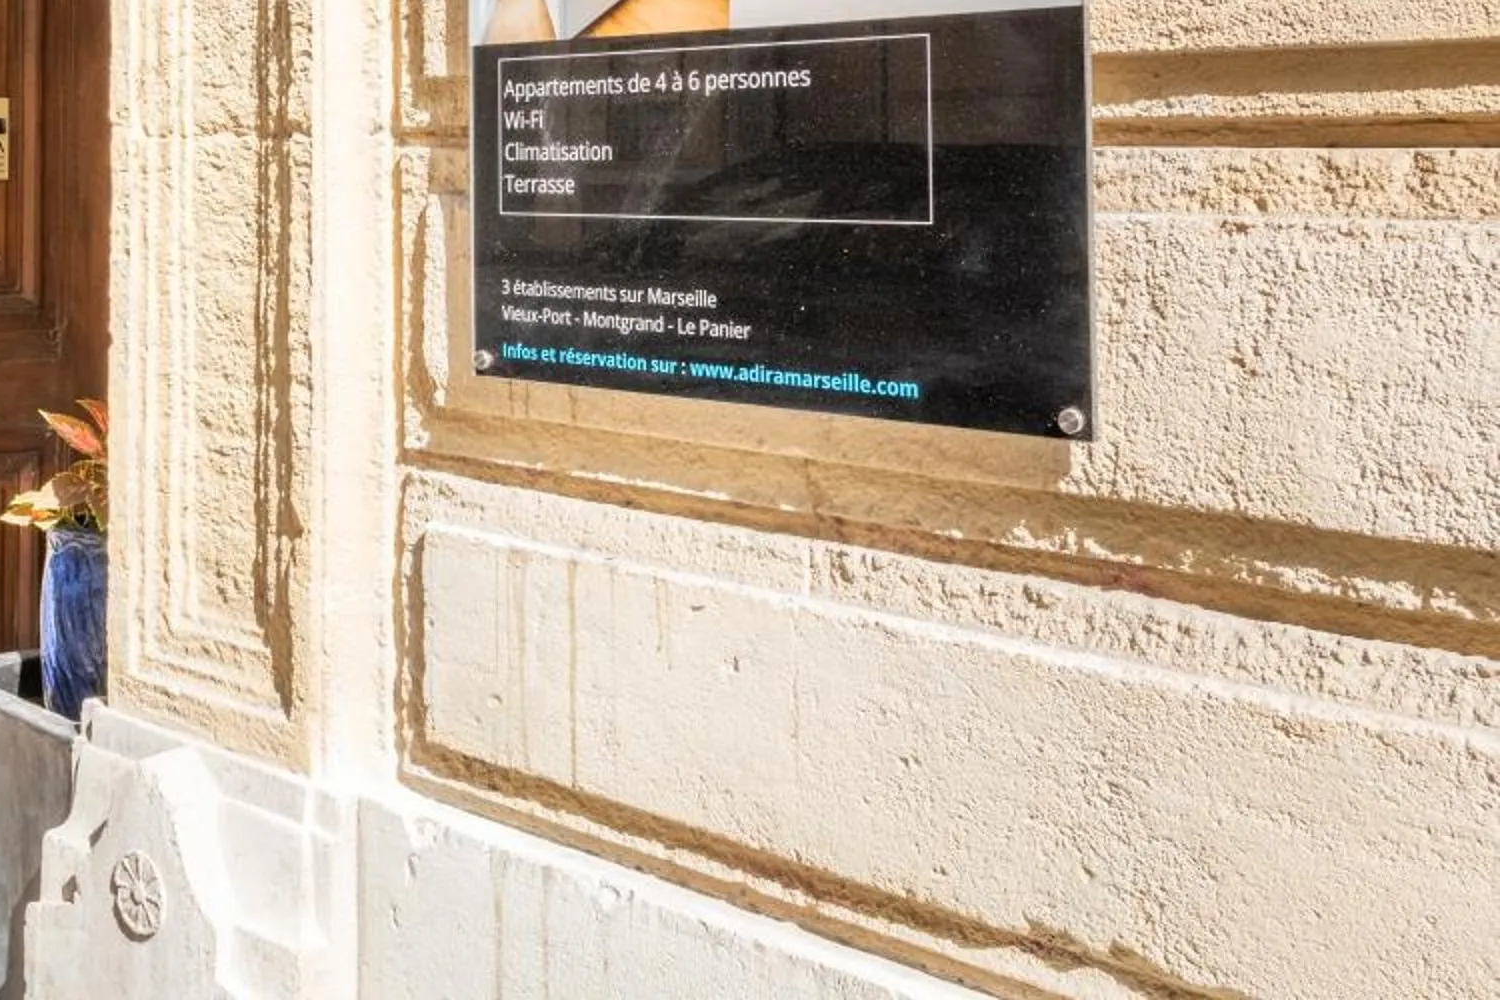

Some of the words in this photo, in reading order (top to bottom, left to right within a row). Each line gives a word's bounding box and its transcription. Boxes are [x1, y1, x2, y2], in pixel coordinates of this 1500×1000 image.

[503, 76, 623, 103] Appartements
[627, 73, 651, 94] de
[655, 75, 667, 93] 4
[671, 71, 683, 92] à
[687, 72, 701, 91] 6
[704, 68, 812, 97] personnes
[503, 109, 545, 130] Wi-Fi
[504, 140, 613, 162] Climatisation
[503, 174, 576, 195] Terrasse
[501, 278, 510, 296] 3
[513, 279, 617, 303] établissements
[619, 287, 644, 304] sur
[647, 287, 718, 309] Marseille
[501, 305, 573, 327] Vieux-Port
[583, 311, 664, 335] Montgrand
[677, 317, 696, 336] Le
[699, 319, 751, 341] Panier
[502, 343, 537, 362] Infos
[541, 347, 556, 363] et
[559, 347, 647, 372] réservation
[650, 359, 677, 375] sur
[689, 363, 919, 400] www.adiramarseille.com
